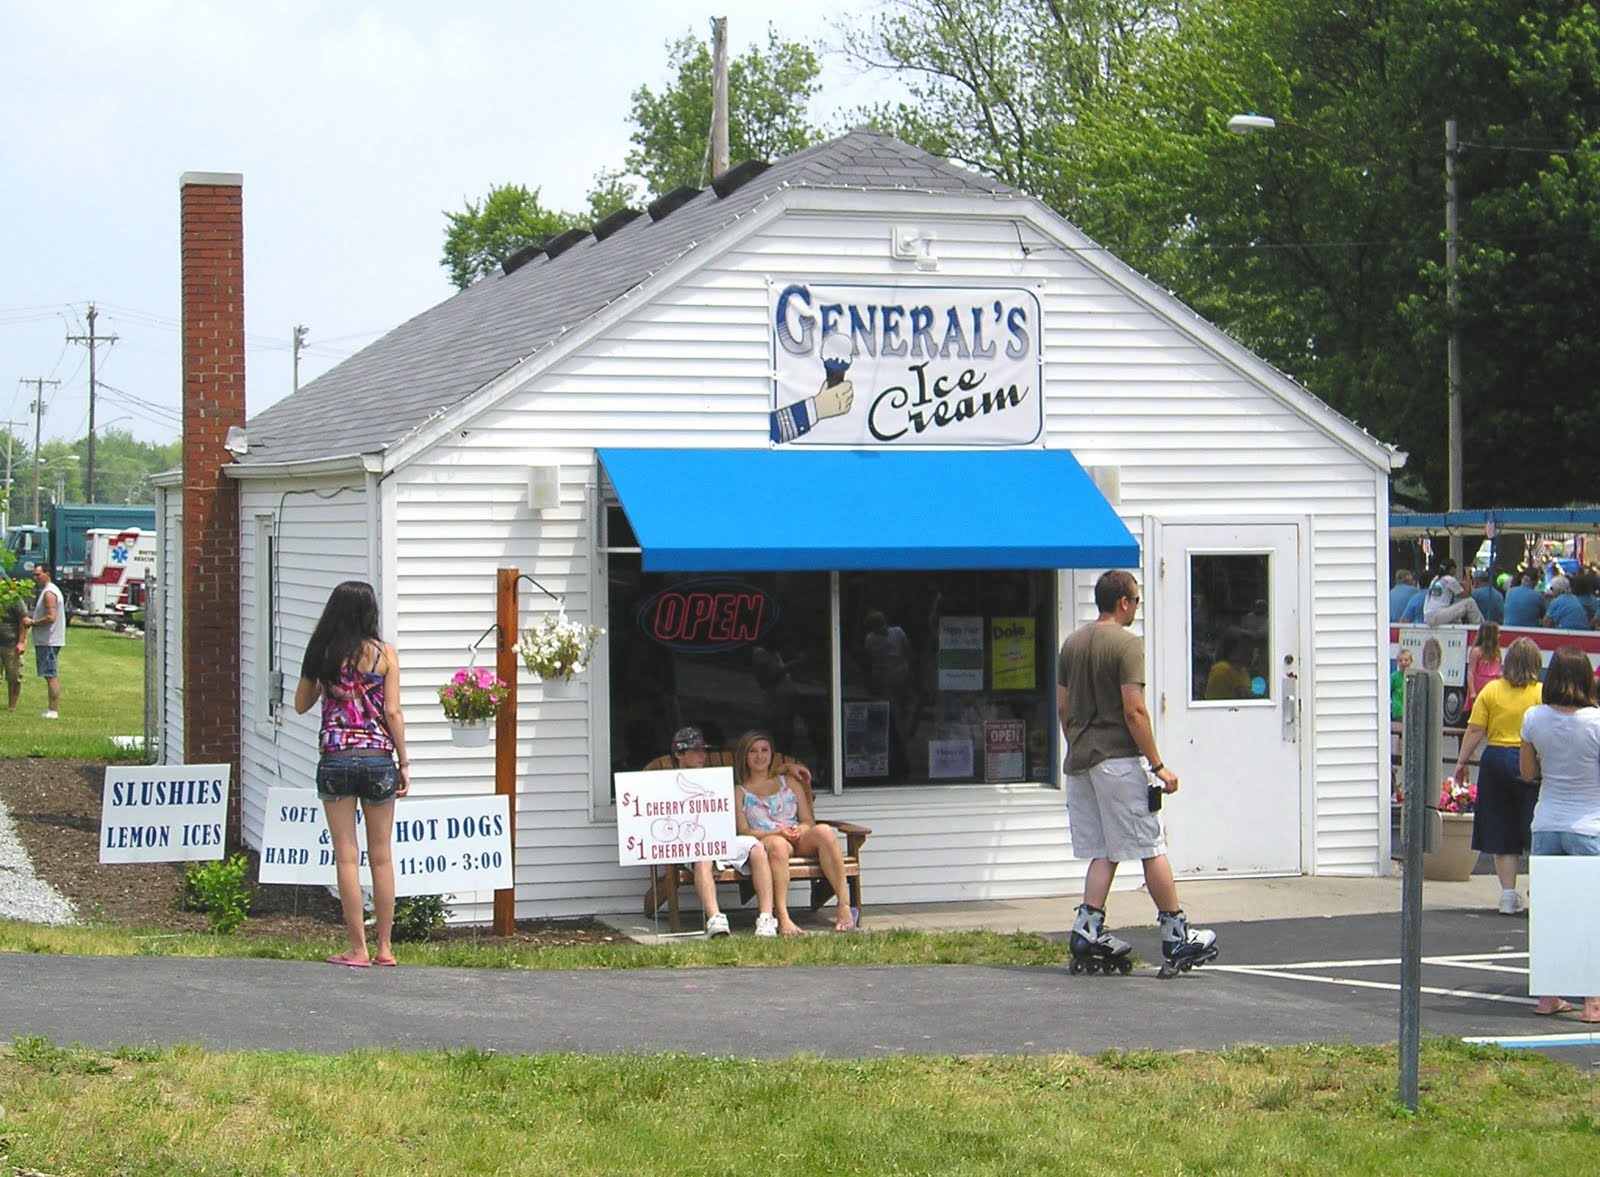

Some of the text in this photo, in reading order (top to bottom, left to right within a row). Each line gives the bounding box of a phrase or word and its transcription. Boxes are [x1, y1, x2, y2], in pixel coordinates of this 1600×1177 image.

[776, 284, 1030, 360] GENERAL'S
[908, 361, 986, 407] Ice
[868, 385, 1030, 441] Cream
[655, 593, 765, 640] OPEN
[993, 622, 1025, 640] Dole
[990, 730, 1020, 743] OPEN
[112, 779, 222, 806] SLUSHIES
[622, 792, 729, 817] $1 CHERRY SUNDAE
[280, 806, 318, 823] SOFT
[106, 823, 221, 848] LEMON ICES
[318, 828, 331, 845] &
[395, 814, 503, 843] HOT DOGS
[265, 847, 309, 864] HARD
[627, 836, 727, 860] $1 CHERRY SLUSH
[399, 855, 447, 875] 11:00
[462, 851, 502, 871] 3:00
